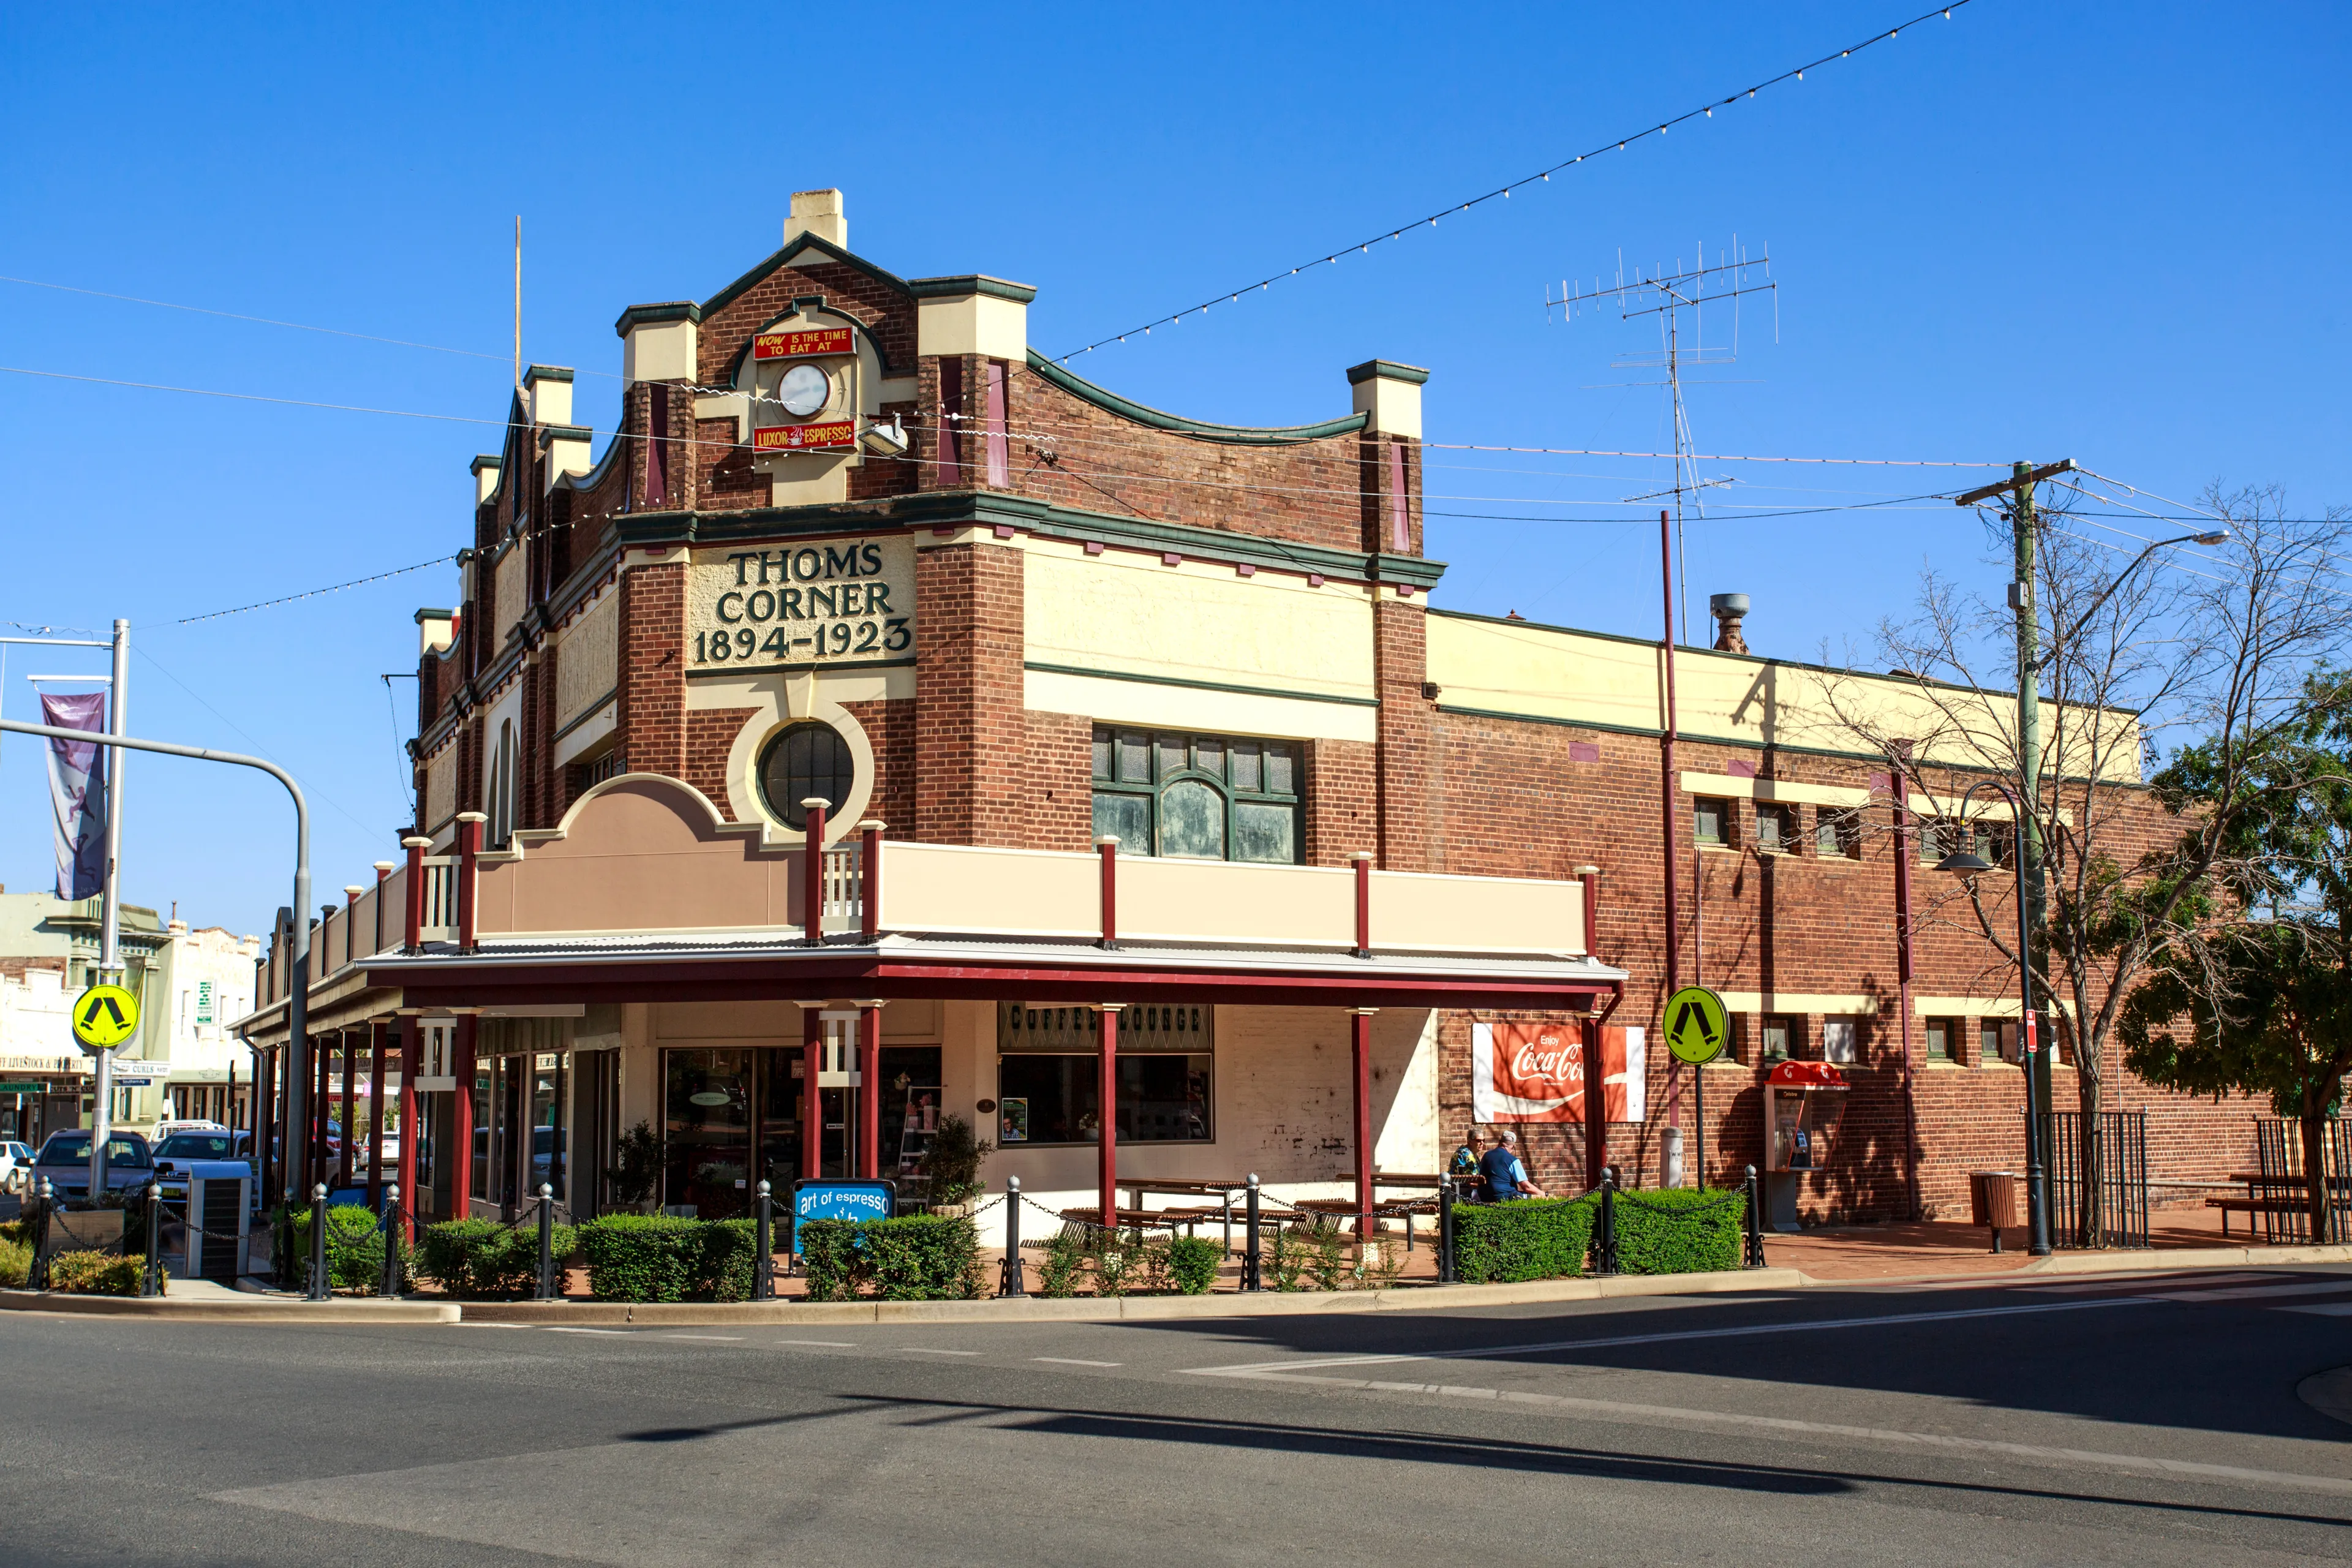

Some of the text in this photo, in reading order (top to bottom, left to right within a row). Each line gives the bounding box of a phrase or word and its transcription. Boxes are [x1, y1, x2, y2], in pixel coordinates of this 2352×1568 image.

[756, 330, 847, 347] NOW IS THE TIME
[770, 342, 832, 355] TO EAT AT
[758, 425, 851, 447] LUXOR ESPRESSO
[726, 539, 883, 586] THOM'S
[717, 582, 894, 624] CORNER
[695, 618, 911, 663] 1894-1923
[1011, 1005, 1199, 1031] COFFEE LOUNGE
[1540, 1035, 1559, 1046] Enjoy
[9, 1057, 44, 1069] LIVESTOCK
[46, 1058, 51, 1069] &
[793, 1068, 804, 1077] OPE
[1512, 1042, 1584, 1081] Coca-Col
[801, 1191, 888, 1215] art of espresso
